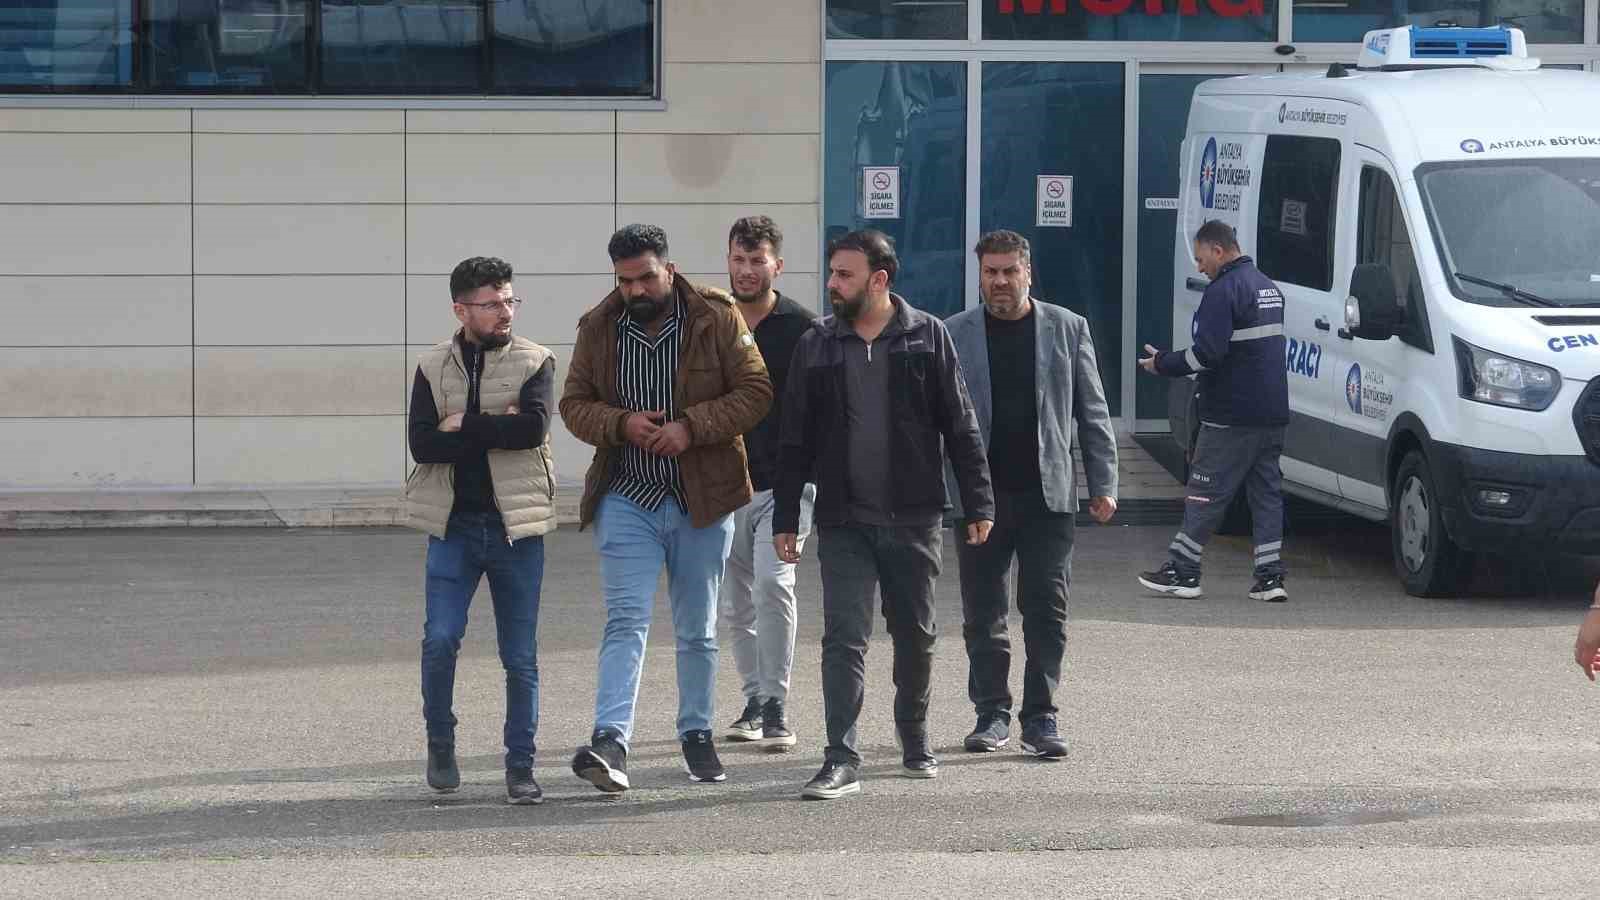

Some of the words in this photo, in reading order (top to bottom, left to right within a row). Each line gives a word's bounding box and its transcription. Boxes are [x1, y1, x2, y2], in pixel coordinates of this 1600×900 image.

[1219, 143, 1242, 160] ANTALYA
[1489, 139, 1546, 150] ANTALYA
[1547, 333, 1599, 352] CEN
[1286, 337, 1321, 379] RACI
